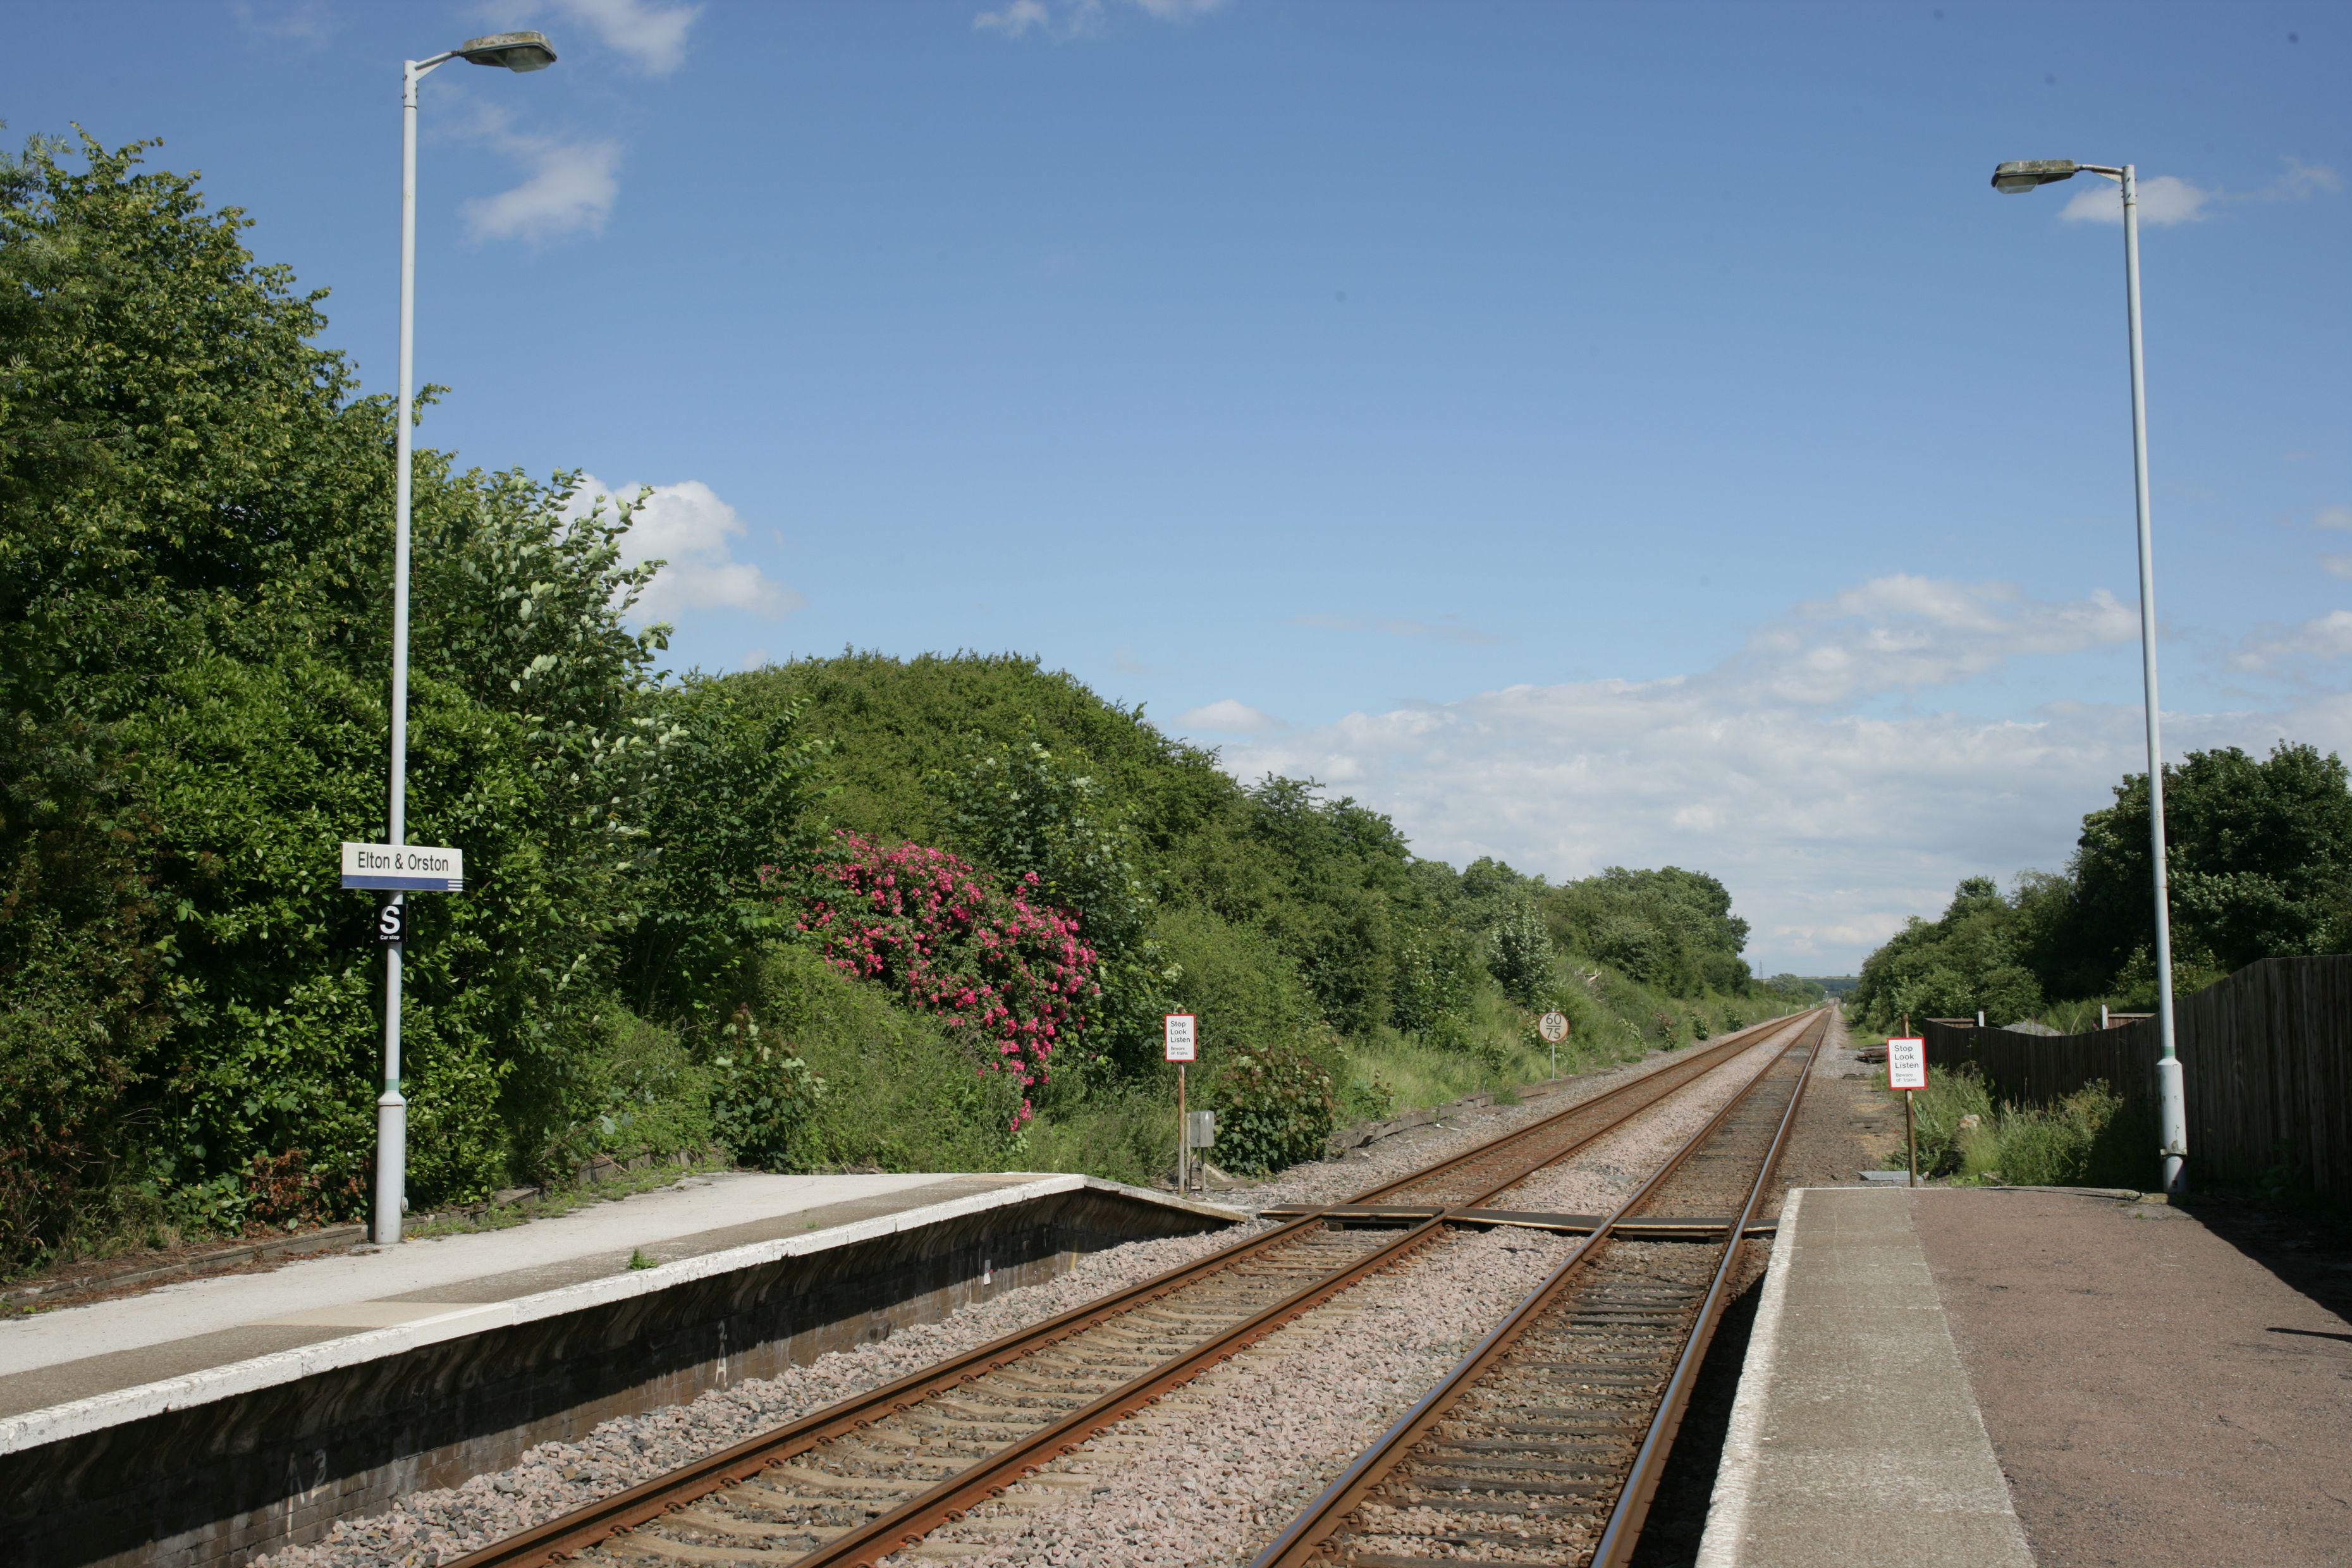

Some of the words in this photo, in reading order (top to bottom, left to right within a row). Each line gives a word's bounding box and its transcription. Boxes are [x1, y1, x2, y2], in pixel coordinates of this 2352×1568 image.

[358, 851, 390, 869] Elton
[395, 853, 403, 870] &
[408, 854, 449, 872] Orston
[379, 905, 400, 934] S
[1546, 1014, 1562, 1025] 60
[1546, 1027, 1561, 1039] 75
[1894, 1044, 1913, 1053] Stop
